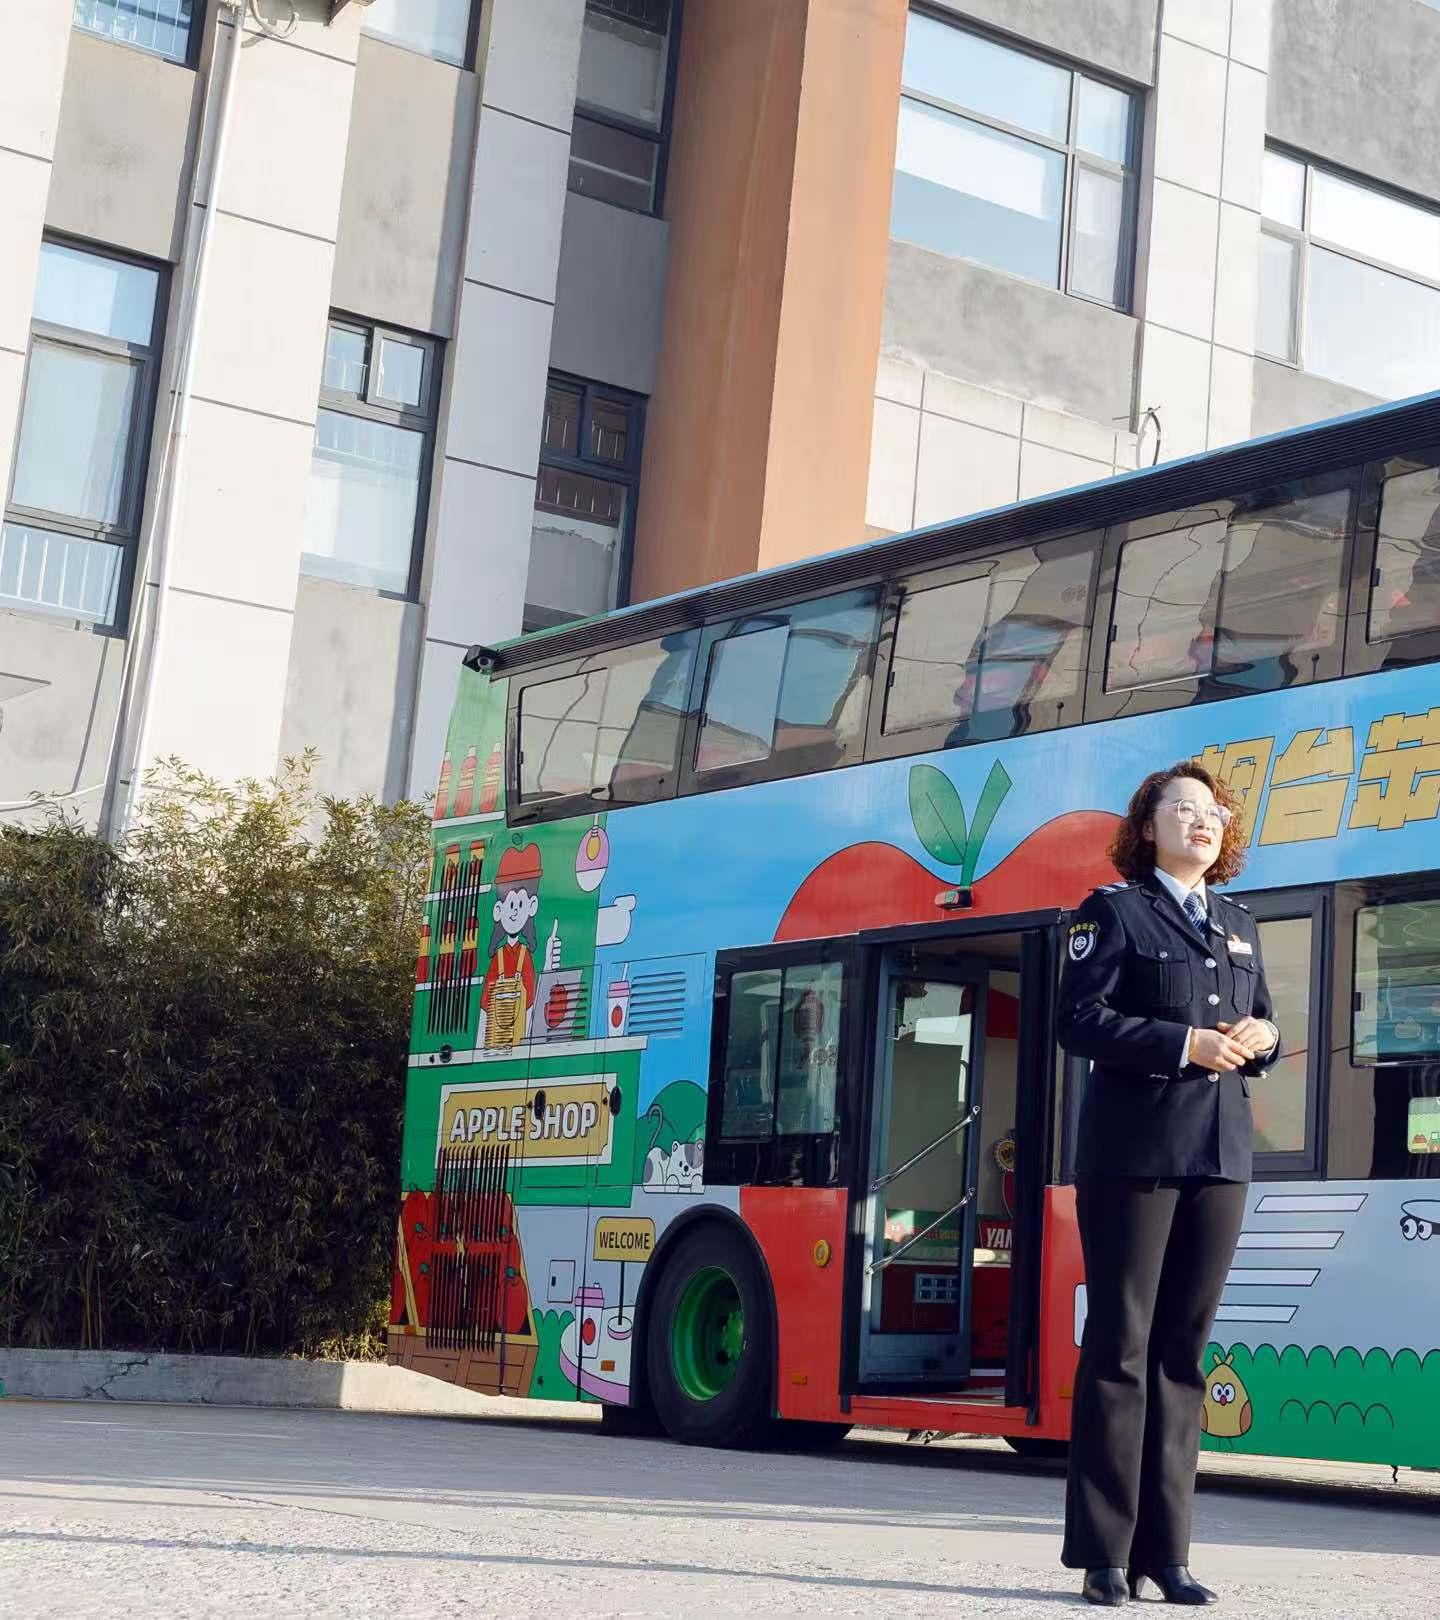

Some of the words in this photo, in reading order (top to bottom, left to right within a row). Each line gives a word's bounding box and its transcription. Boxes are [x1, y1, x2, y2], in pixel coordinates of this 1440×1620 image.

[449, 1104, 524, 1143] APPLE
[529, 1100, 599, 1141] SHOP
[599, 1230, 650, 1251] WELCOME
